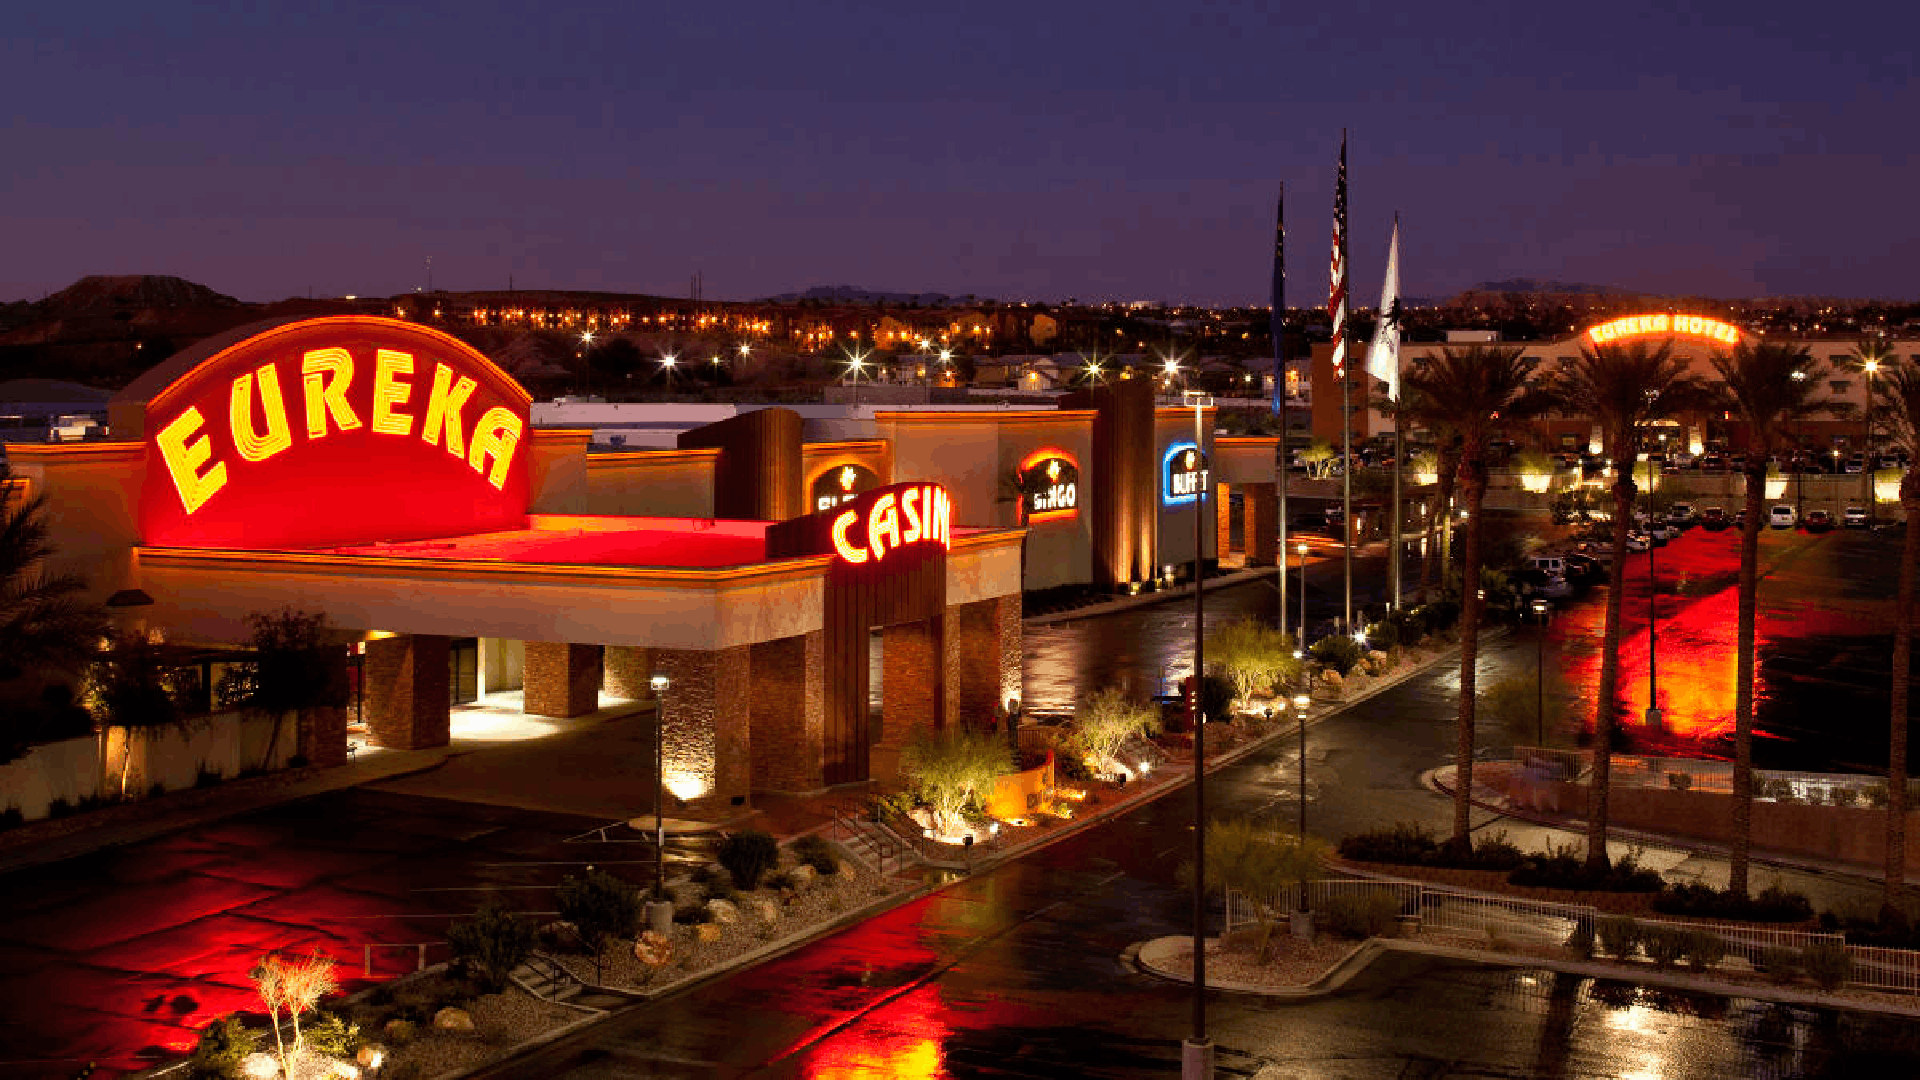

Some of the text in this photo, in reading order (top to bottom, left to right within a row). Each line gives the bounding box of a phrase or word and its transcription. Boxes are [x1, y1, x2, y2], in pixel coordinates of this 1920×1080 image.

[1588, 314, 1738, 345] EUREKA HOTEL
[157, 347, 523, 515] EUREKA
[1173, 470, 1208, 494] BUFFT
[832, 486, 951, 563] CASIN
